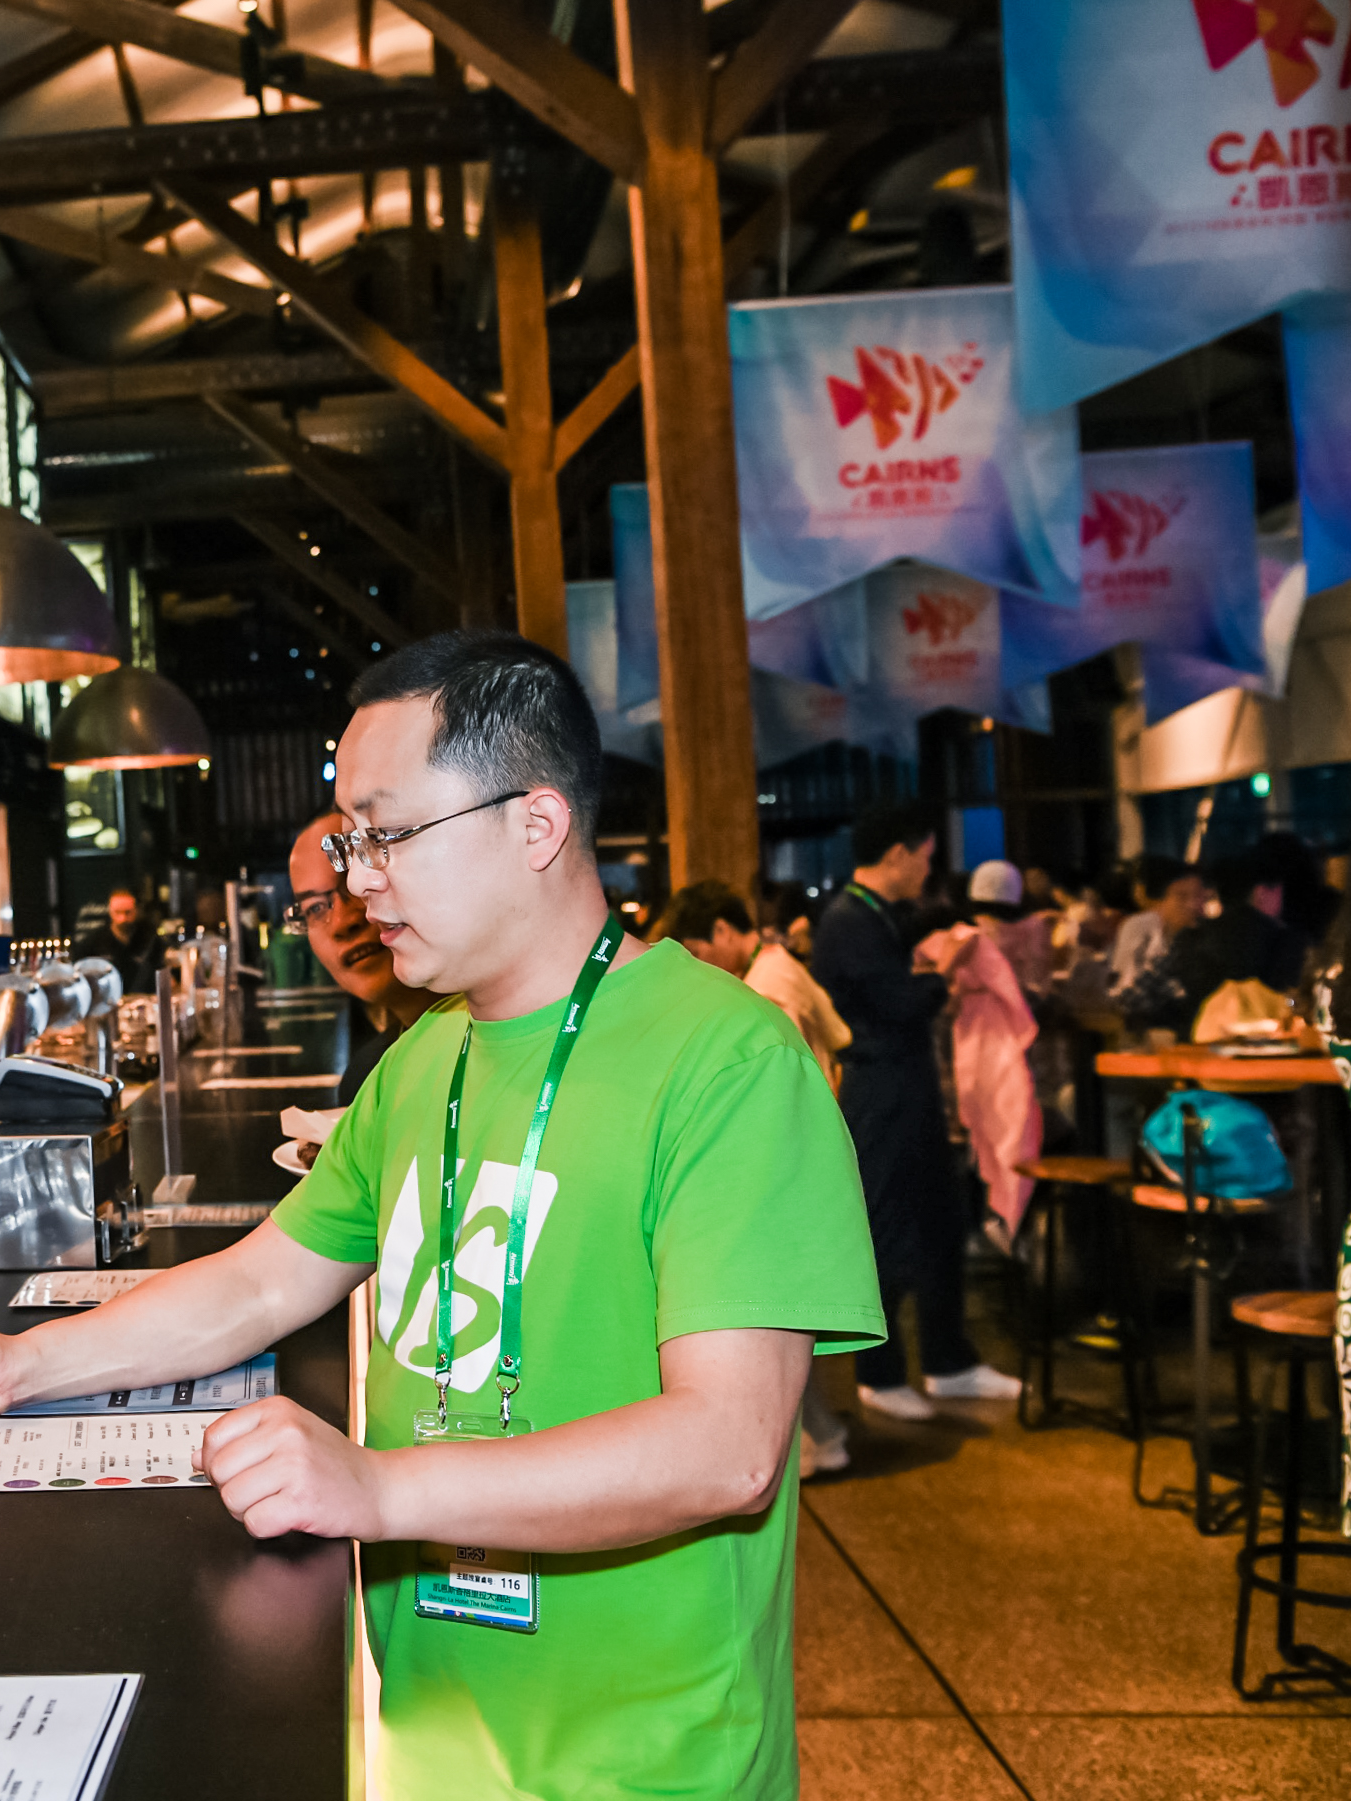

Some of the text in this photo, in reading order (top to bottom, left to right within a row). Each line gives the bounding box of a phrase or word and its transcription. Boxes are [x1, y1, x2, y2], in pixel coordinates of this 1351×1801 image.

[1207, 123, 1351, 176] CAIR
[838, 455, 962, 489] CAIRNS
[501, 1577, 521, 1591] 116
[469, 1599, 480, 1607] The
